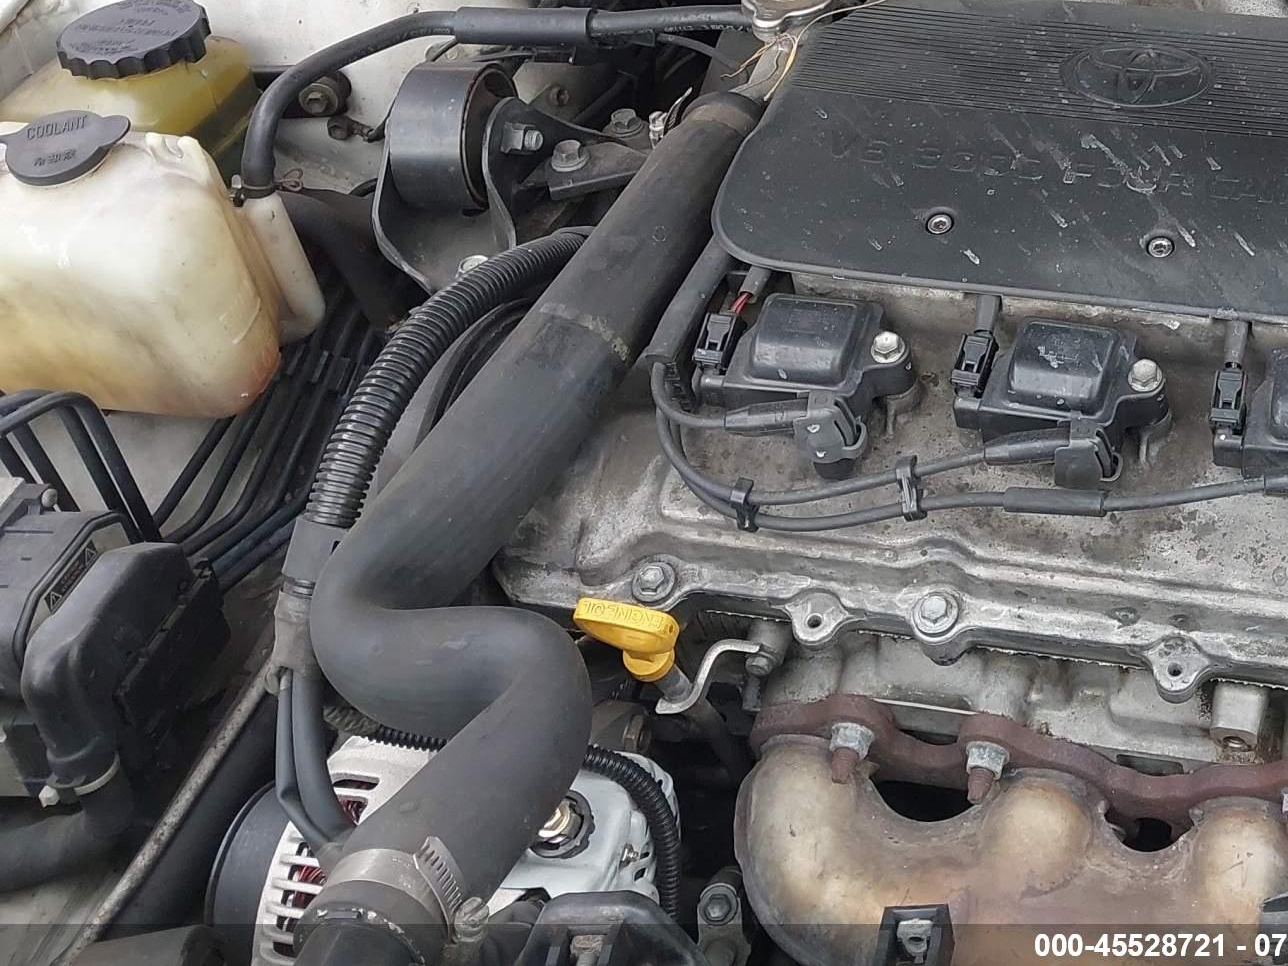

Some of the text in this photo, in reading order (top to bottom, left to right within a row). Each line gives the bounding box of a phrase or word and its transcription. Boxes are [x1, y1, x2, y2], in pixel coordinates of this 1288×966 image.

[27, 115, 89, 141] COOLANT
[584, 601, 663, 629] ENGINE OIL
